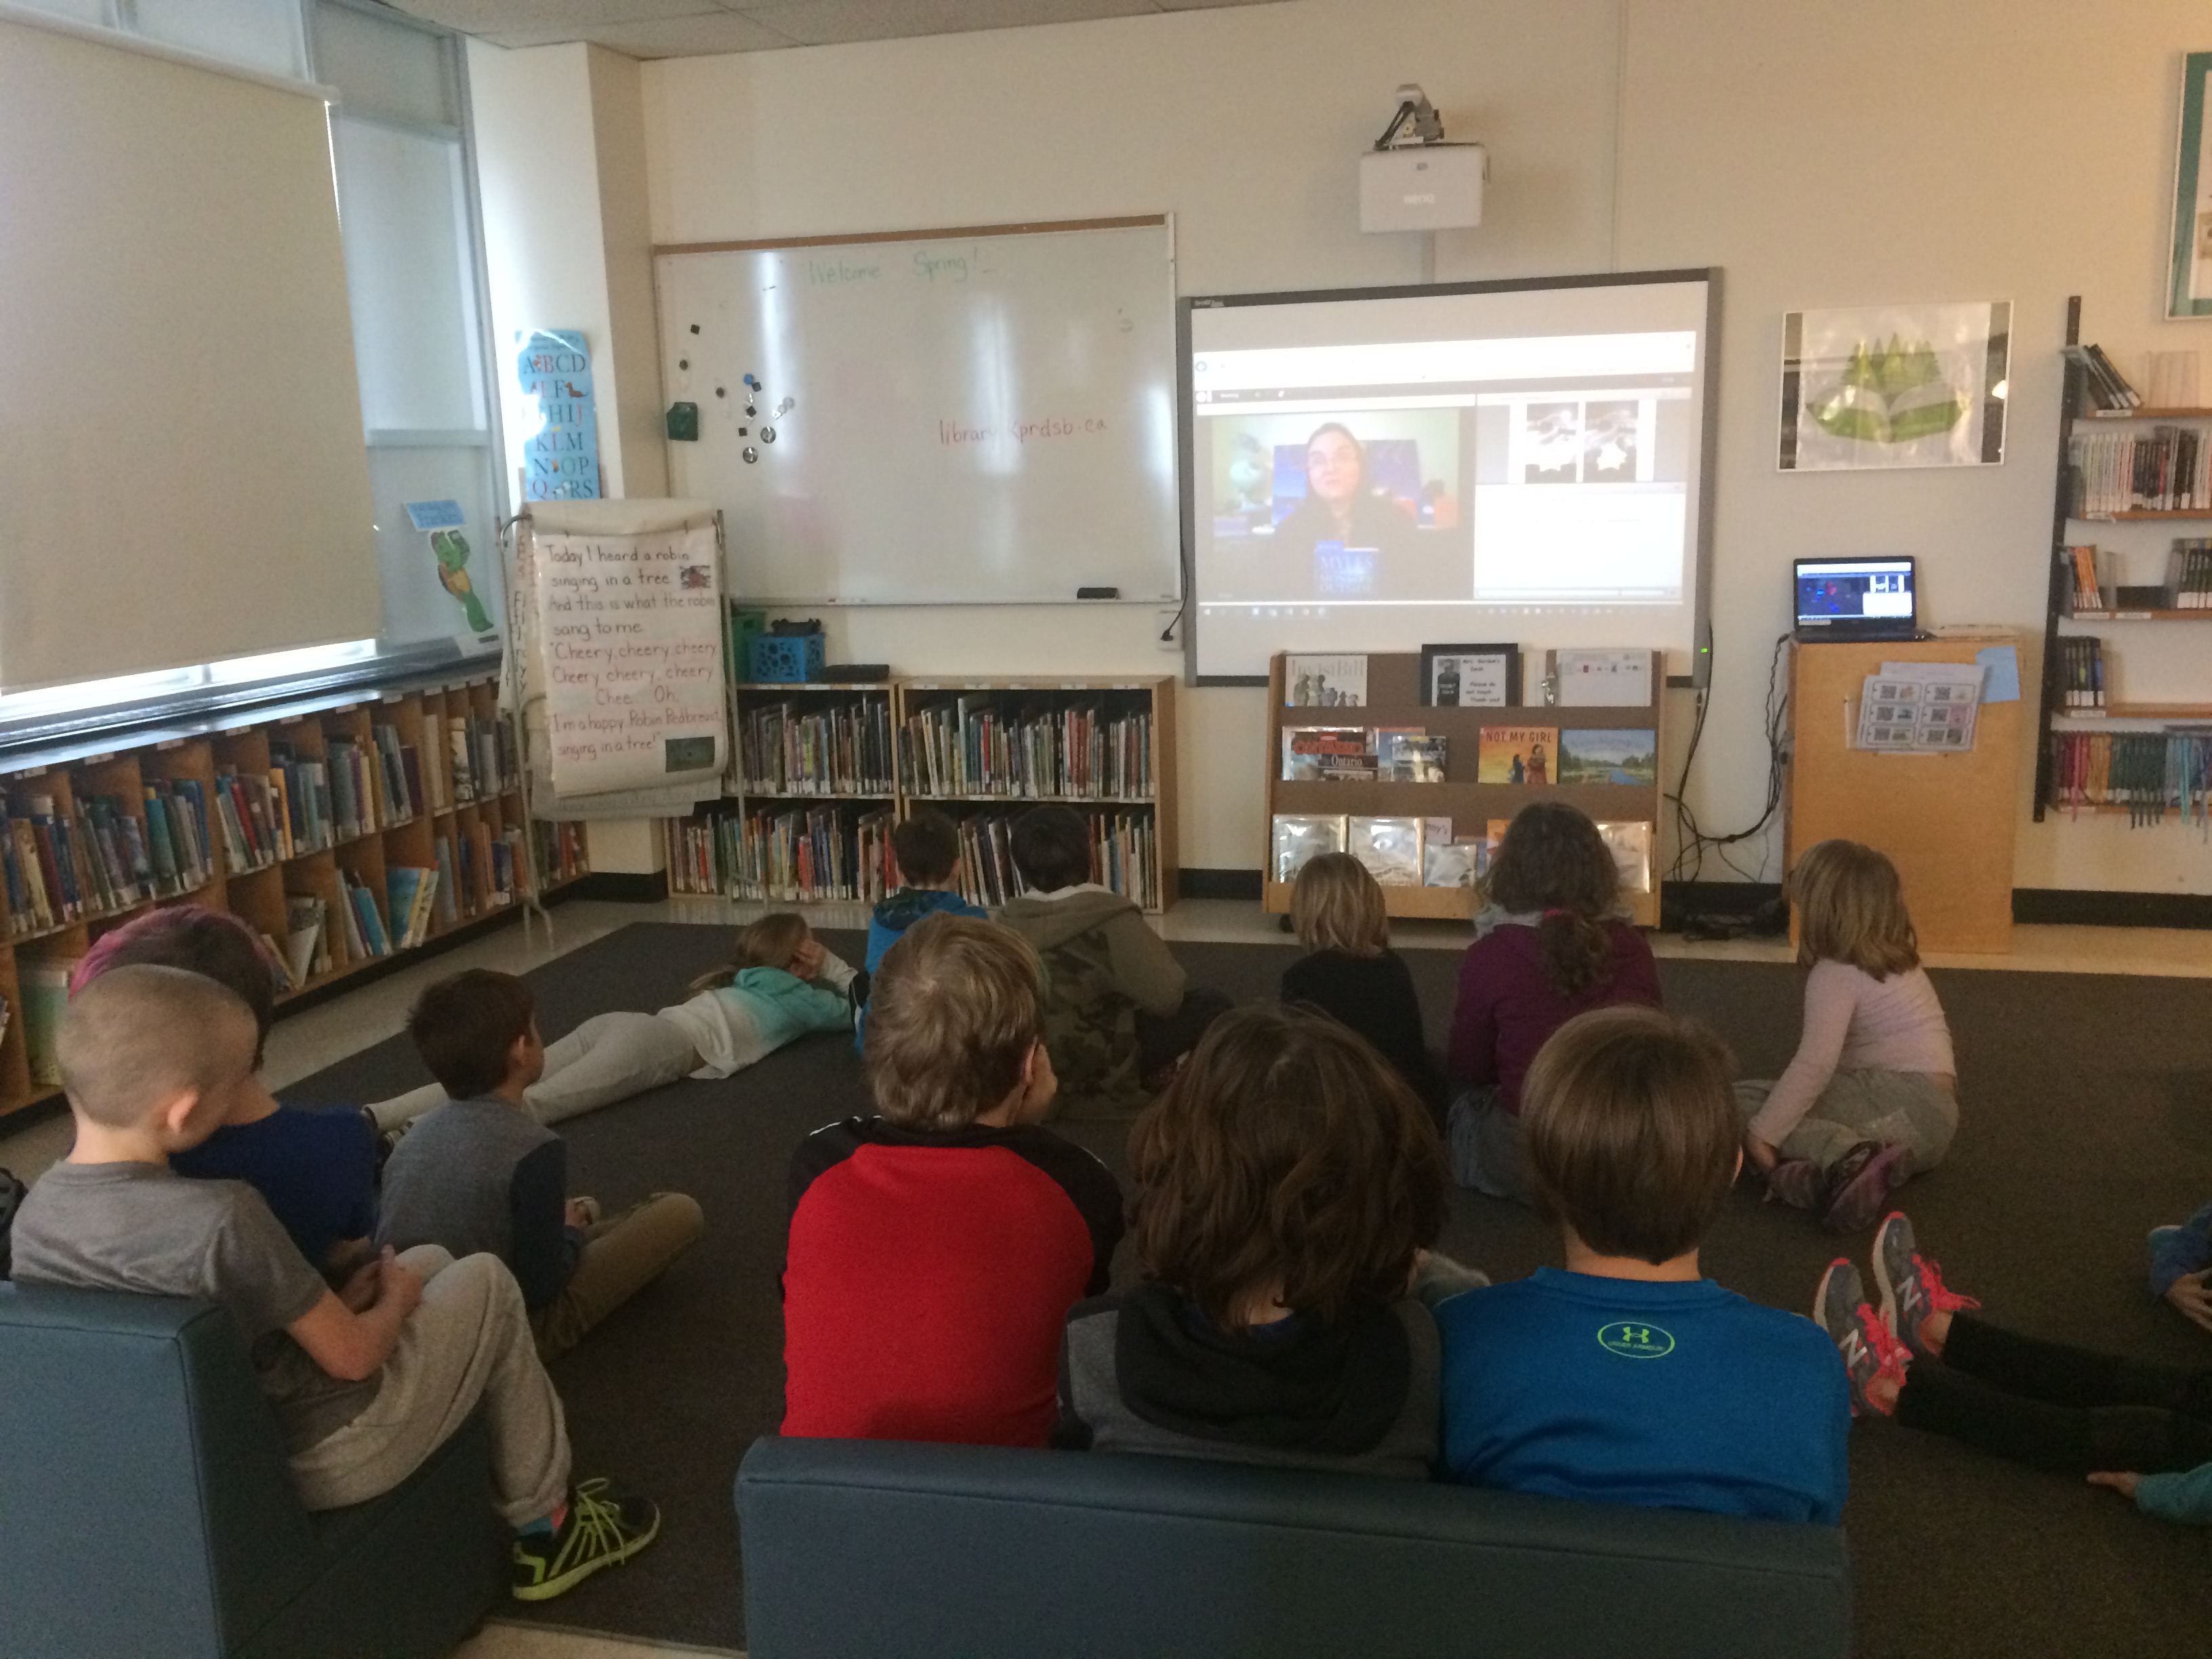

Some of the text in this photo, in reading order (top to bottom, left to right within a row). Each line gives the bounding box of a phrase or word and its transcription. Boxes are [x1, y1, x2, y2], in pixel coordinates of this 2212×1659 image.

[809, 260, 881, 285] Welcome
[544, 544, 689, 567] Today I heard a robin
[551, 568, 671, 593] singing in a tree
[548, 591, 716, 611] And this is what the robin
[553, 617, 642, 642] sang to me
[579, 720, 587, 730] a
[587, 714, 624, 733] happy
[629, 710, 663, 727] Robin
[1486, 731, 1553, 743] NOT MY GIRL
[558, 744, 598, 761] singing
[601, 743, 613, 753] in
[615, 742, 623, 751] a
[1330, 755, 1363, 767] Ontario
